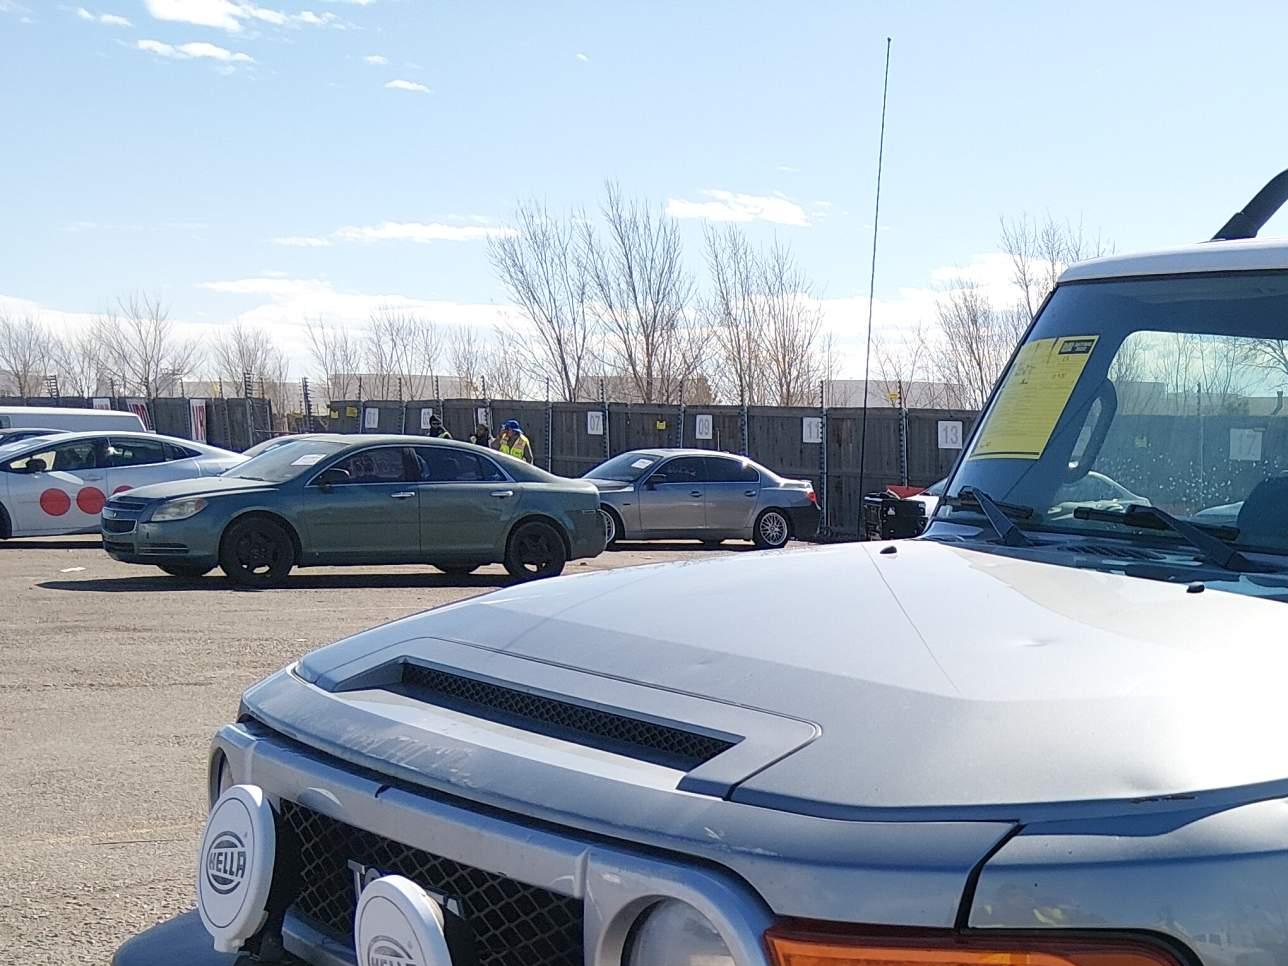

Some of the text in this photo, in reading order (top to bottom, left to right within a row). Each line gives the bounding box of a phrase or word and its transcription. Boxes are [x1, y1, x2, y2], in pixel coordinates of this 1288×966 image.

[589, 415, 601, 431] 07
[698, 417, 710, 435] 09
[943, 425, 959, 444] 13
[207, 849, 247, 879] HELLA
